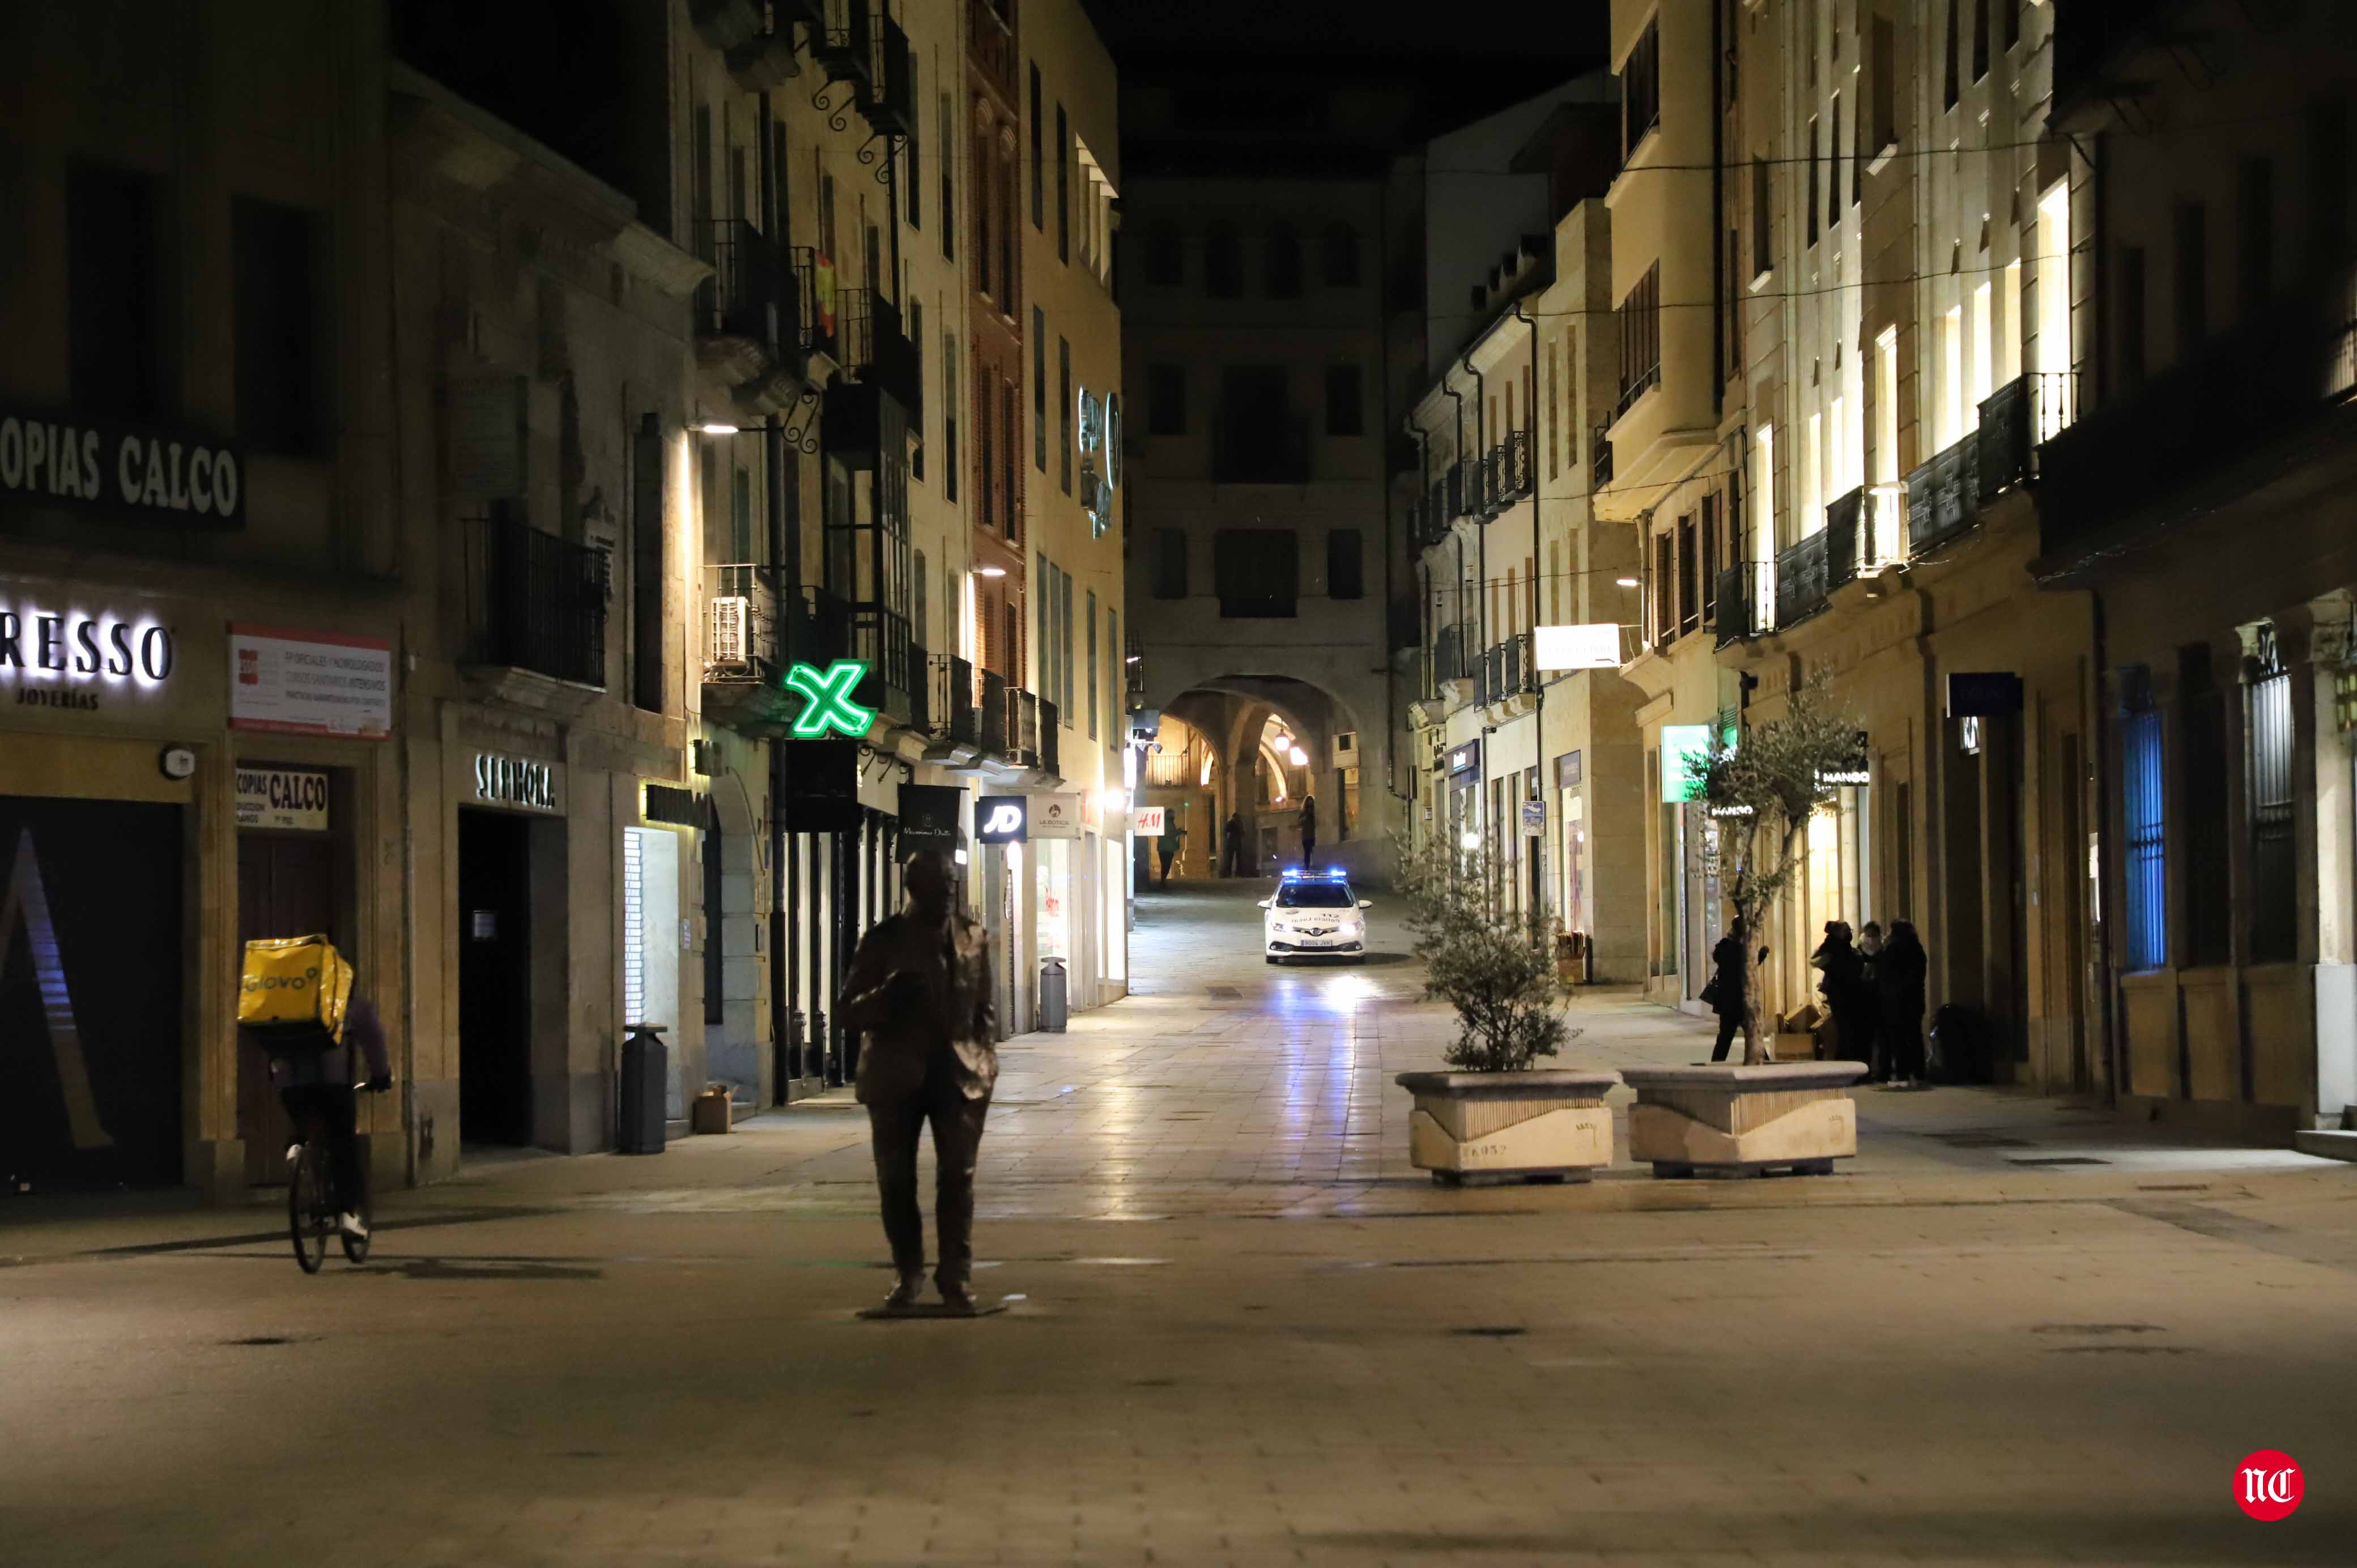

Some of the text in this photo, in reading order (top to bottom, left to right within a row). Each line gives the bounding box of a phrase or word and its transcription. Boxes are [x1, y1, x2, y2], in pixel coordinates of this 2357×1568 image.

[119, 433, 237, 517] CALCO
[270, 774, 326, 811] CALCO
[1823, 771, 1870, 783] MANGO
[984, 805, 1022, 834] JD
